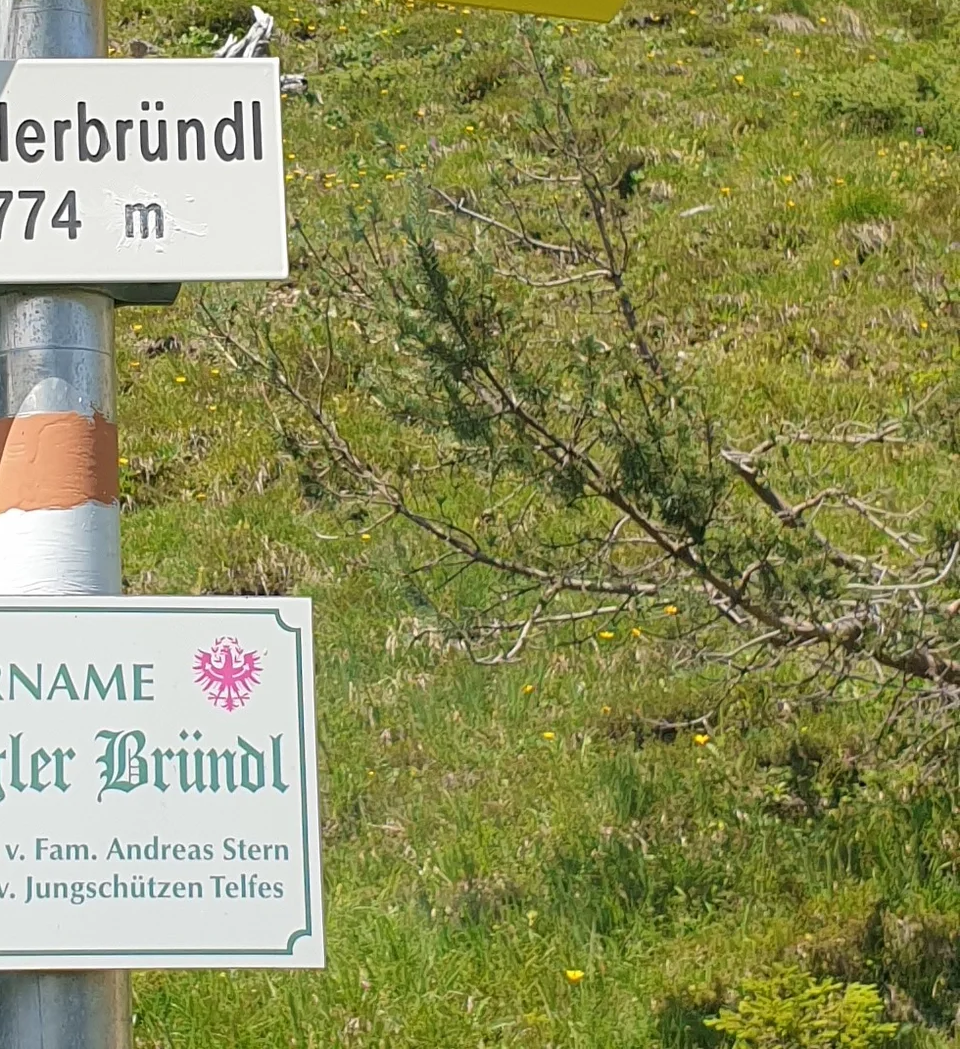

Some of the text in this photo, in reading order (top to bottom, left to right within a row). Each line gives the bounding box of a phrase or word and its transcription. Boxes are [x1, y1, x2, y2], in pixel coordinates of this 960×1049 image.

[124, 202, 164, 240] m
[94, 729, 290, 803] Bründl
[5, 844, 25, 861] v.
[35, 837, 97, 861] Fam.
[106, 835, 214, 861] Andreas
[223, 837, 289, 861] Stern
[24, 873, 203, 905] Jungschützen
[209, 873, 284, 899] Telfes
